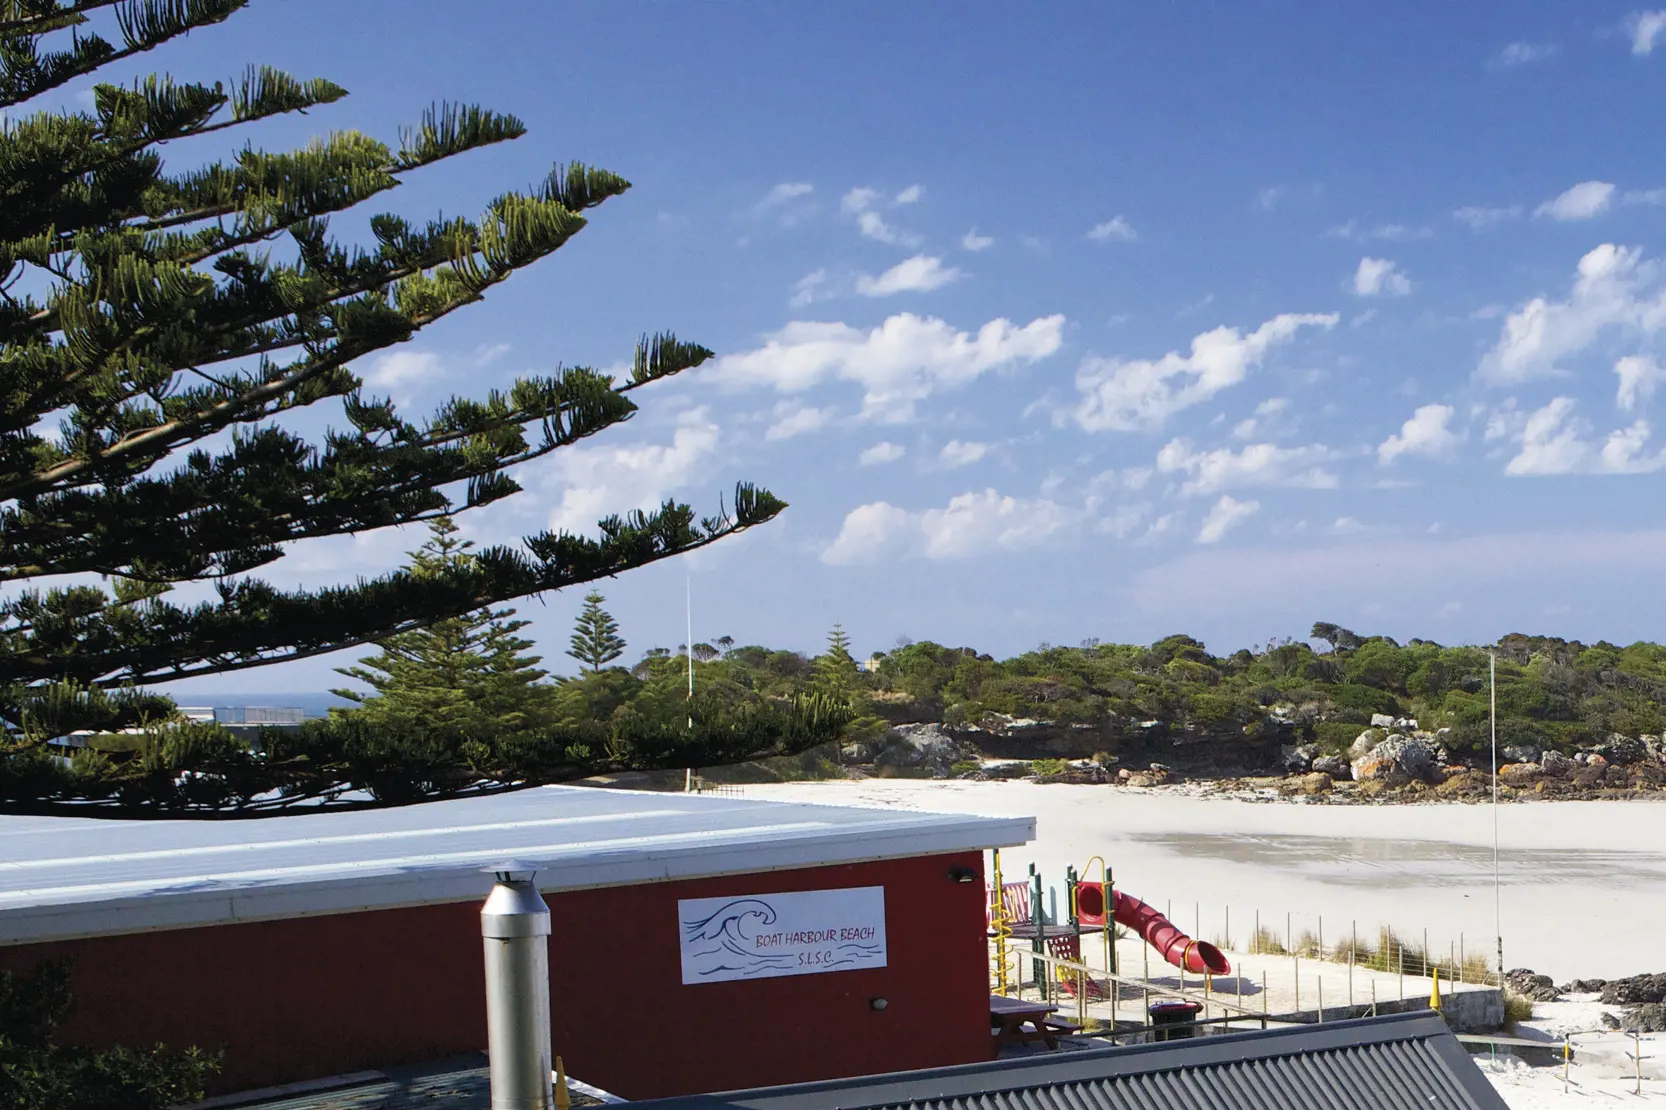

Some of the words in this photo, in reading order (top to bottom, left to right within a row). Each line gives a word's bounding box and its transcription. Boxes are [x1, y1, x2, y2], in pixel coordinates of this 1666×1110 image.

[756, 934, 782, 948] BOAT
[785, 929, 837, 944] HARBOUR
[840, 927, 875, 940] BEACH
[798, 951, 834, 966] S.L.S.C.
